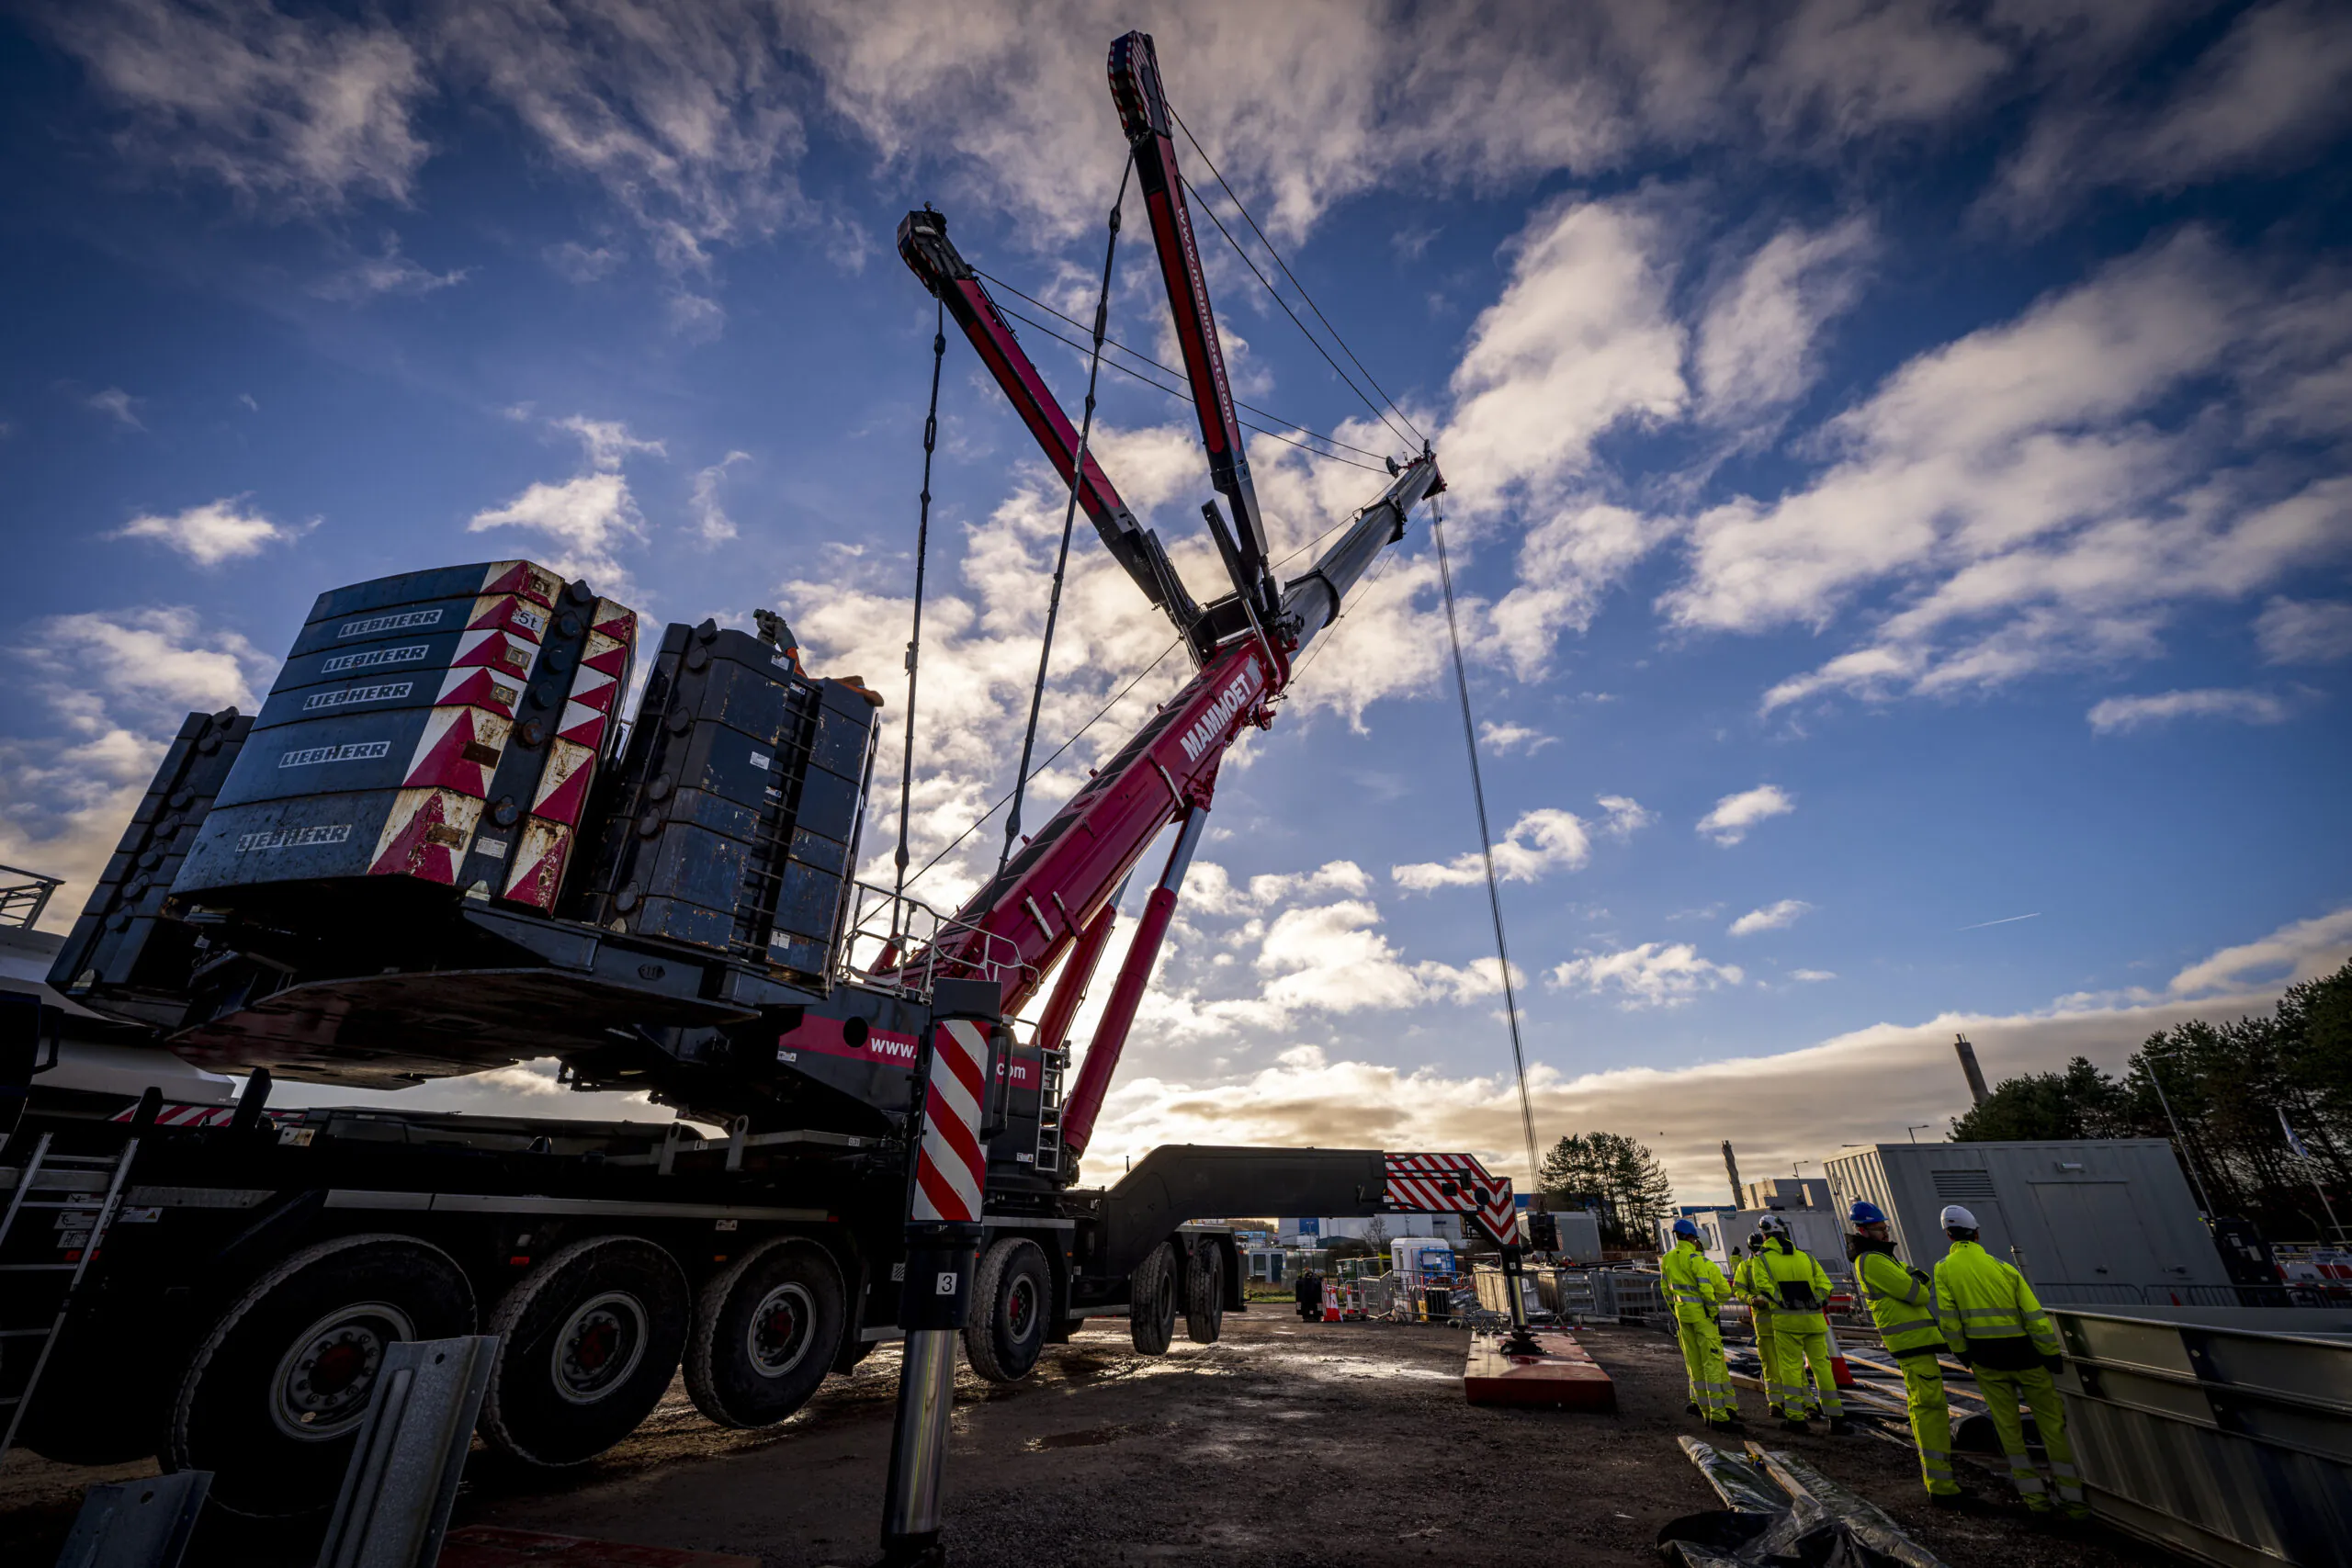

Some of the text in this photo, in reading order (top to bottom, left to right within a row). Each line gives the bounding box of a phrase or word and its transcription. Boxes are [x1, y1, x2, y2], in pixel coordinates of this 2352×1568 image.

[338, 609, 443, 638] LIEBHERR
[321, 645, 430, 673] LIEBHERR
[303, 682, 413, 710] LIEBHERR
[1180, 672, 1251, 762] MAMMOET
[278, 741, 391, 768] LIEBHERR
[942, 1275, 953, 1292] 3
